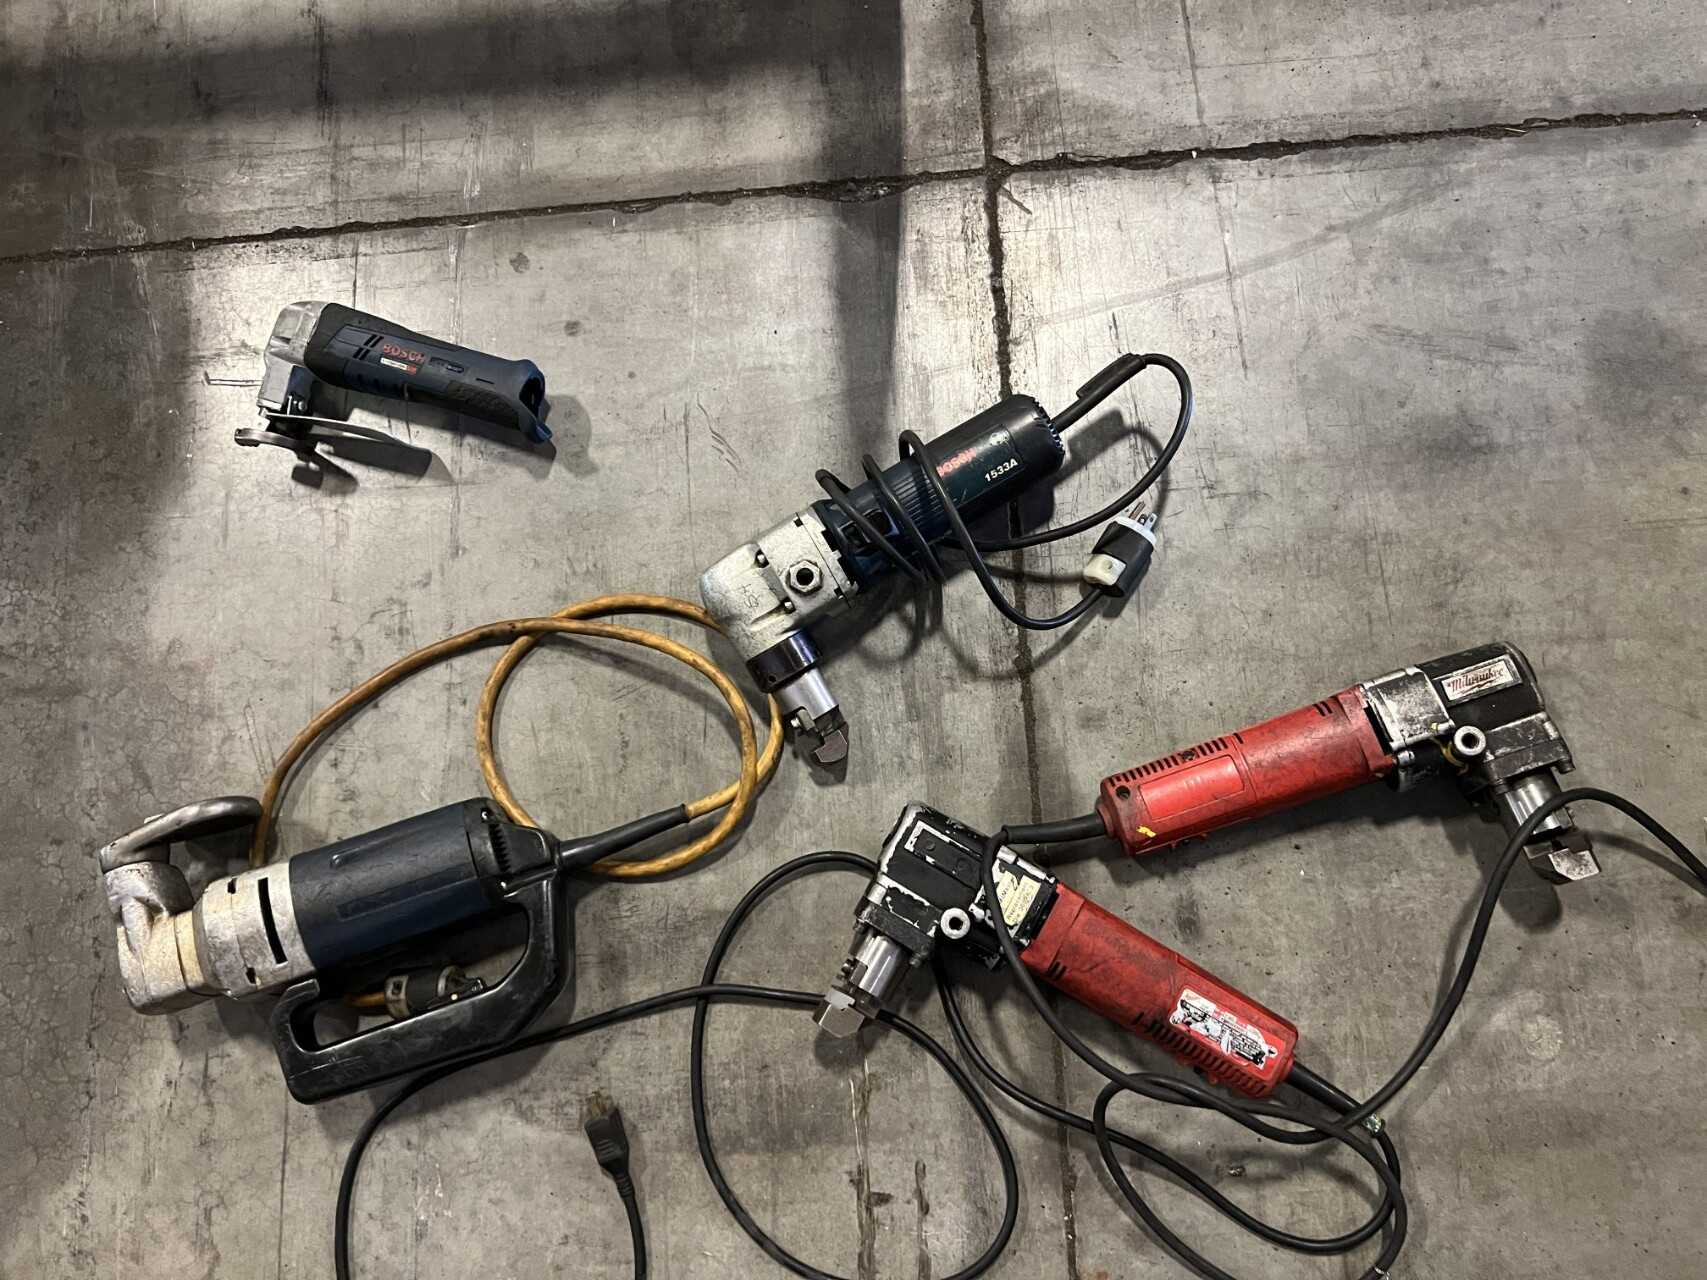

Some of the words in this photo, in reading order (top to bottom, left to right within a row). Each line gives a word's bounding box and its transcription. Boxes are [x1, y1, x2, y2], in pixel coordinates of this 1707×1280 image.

[383, 343, 426, 362] BOSCH
[984, 458, 1018, 482] 1533A
[1448, 668, 1504, 692] Milwaukee
